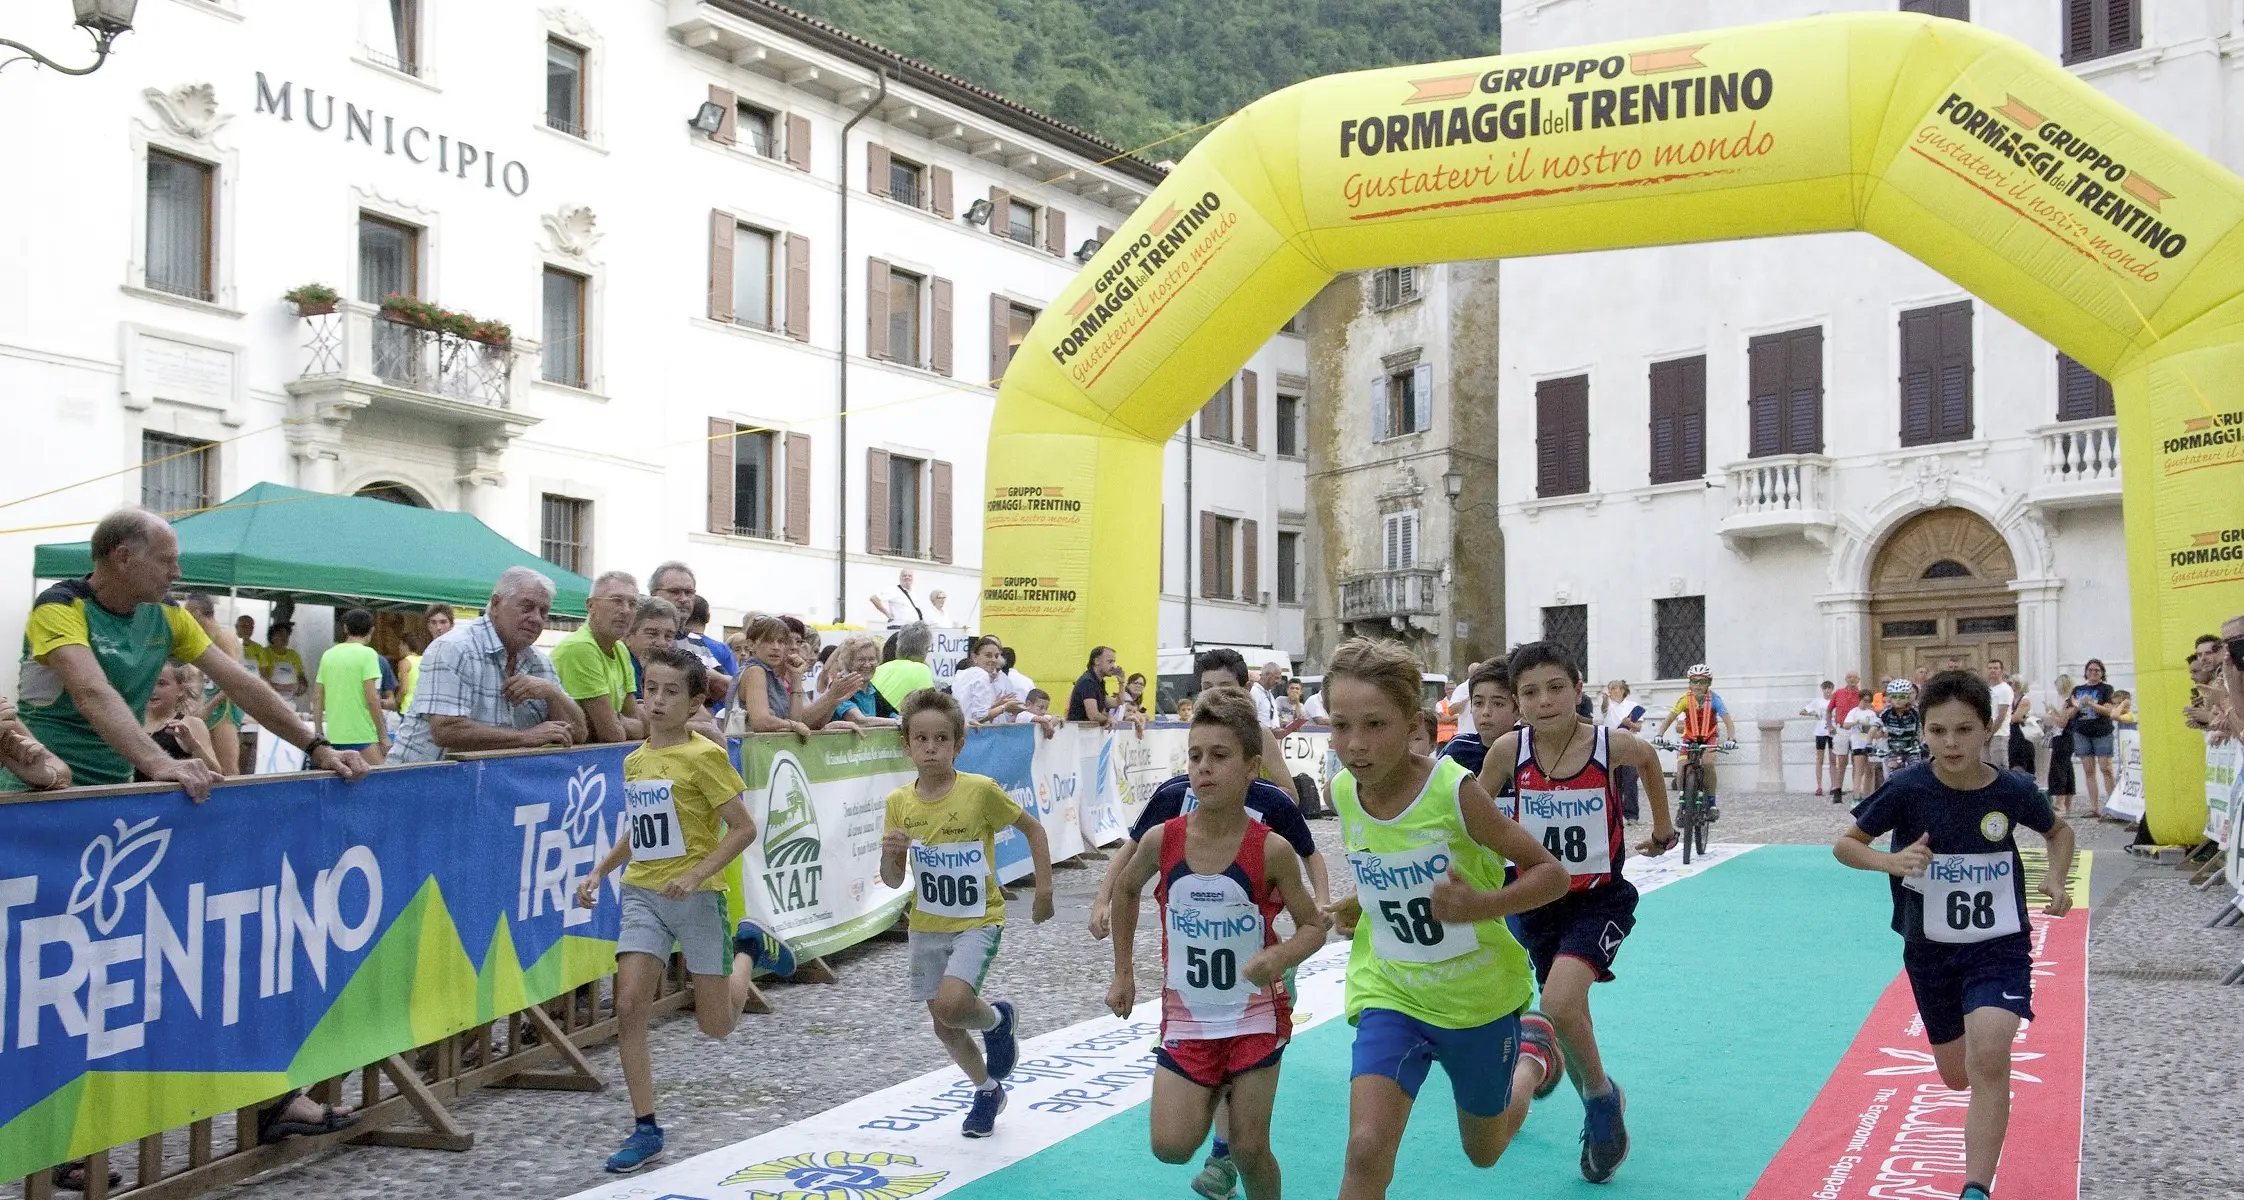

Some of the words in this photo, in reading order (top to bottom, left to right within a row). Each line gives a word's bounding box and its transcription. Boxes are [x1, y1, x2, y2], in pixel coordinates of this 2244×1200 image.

[1480, 55, 1624, 95] GRUPPO
[1340, 98, 1540, 158] FORMAGGI
[1543, 107, 1569, 135] del
[1568, 68, 1773, 132] TRENTINO
[254, 71, 529, 196] MUNICIPIO
[2038, 122, 2126, 182] GRUPPO
[1343, 155, 1498, 208] Gustatevi
[1506, 148, 1535, 184] il
[1543, 138, 1642, 179] nostro
[1654, 120, 1775, 167] mondo
[1937, 93, 2064, 183] FORMAGGI
[2050, 172, 2069, 196] del
[2066, 172, 2187, 259] TRENTINO
[1919, 125, 2015, 188] Gustatevi
[2009, 180, 2036, 201] il
[2026, 196, 2089, 237] nostro
[2089, 236, 2159, 282] mondo
[1138, 191, 1221, 276] TRENTINO
[1094, 233, 1152, 294] GRUPPO
[1135, 271, 1150, 288] del
[1072, 312, 1136, 383] Gustatevi
[1134, 297, 1148, 318] il
[1149, 261, 1189, 304] nostro
[1191, 212, 1237, 262] mondo
[1052, 275, 1139, 366] FORMAGGI
[2164, 428, 2241, 455] FORMAGGI
[1008, 487, 1042, 497] GRUPPO
[1028, 499, 1081, 511] TRENTINO
[1003, 577, 1037, 587] GRUPPO
[1023, 590, 1076, 601] TRENTINO
[1521, 795, 1604, 819] TRENTINO
[632, 812, 670, 849] 607
[1543, 825, 1588, 863] 48
[911, 846, 982, 869] TRENTINO
[1351, 854, 1450, 891] TRENTINO
[1929, 860, 2010, 884] TRENTINO
[763, 865, 822, 915] NAT
[920, 871, 978, 907] 606
[1169, 908, 1257, 941] TRENTINO
[1379, 896, 1445, 946] 58
[1946, 890, 1996, 931] 68
[1186, 945, 1237, 991] 50
[1873, 1087, 1898, 1104] The
[1848, 1105, 1889, 1152] Ergonomic
